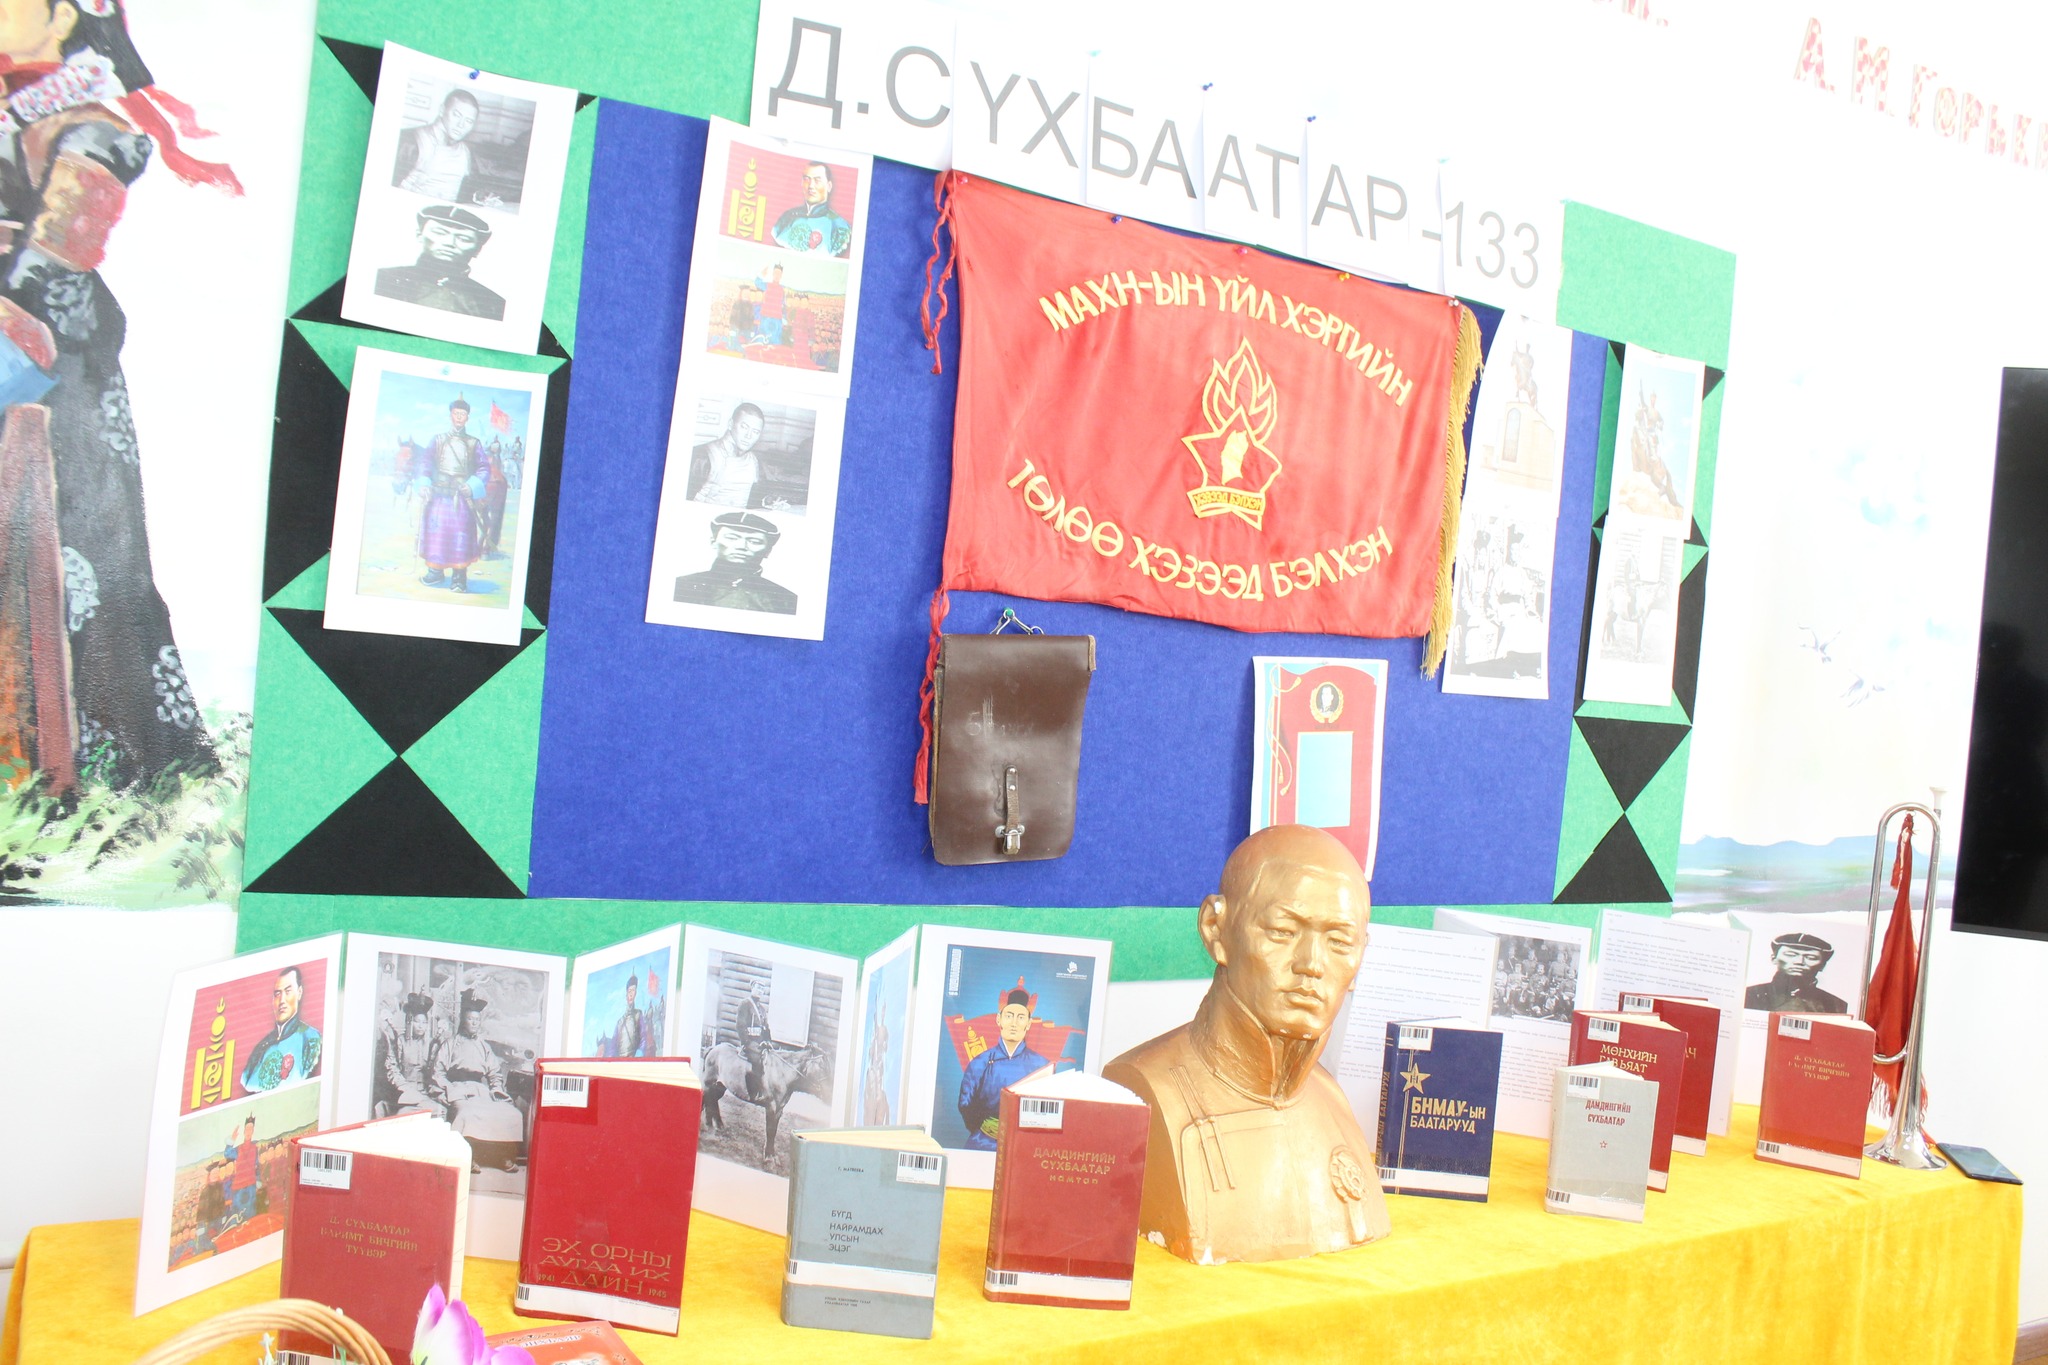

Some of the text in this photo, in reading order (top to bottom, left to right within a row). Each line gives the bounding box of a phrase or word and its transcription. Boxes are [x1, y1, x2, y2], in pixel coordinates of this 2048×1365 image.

[1039, 270, 1414, 407] МАХН-ЫН ҮЙЛ ХЭРГИЙН
[1006, 459, 1393, 601] ТӨЛӨӨ ХЭЗЭЭД БЭЛХЭН
[1600, 1044, 1658, 1064] МӨНХИЙН
[1411, 1097, 1487, 1120] БНМАУ-ЫН
[1585, 1099, 1632, 1114] ДАМДИНГИЙН
[1410, 1115, 1476, 1135] БААТАРУУД
[1587, 1113, 1626, 1127] СҮХБААТАР
[1033, 1147, 1117, 1165] ДАМДИНГИЙН
[1041, 1159, 1111, 1175] СҮХБААТАР
[831, 1209, 853, 1221] БҮГД
[345, 1218, 410, 1237] СҮХБААТАР
[829, 1222, 884, 1236] НАЙРАМДАХ
[368, 1235, 419, 1252] БИЧГИЙН
[829, 1233, 860, 1244] УЛСЫН
[542, 1237, 673, 1270] ЭХ ОРНЫ
[828, 1243, 851, 1254] ЭЦЭГ
[539, 1255, 671, 1282] АУГАА ИХ
[560, 1270, 644, 1296] ДАЙН
[648, 1287, 668, 1299] 1945
